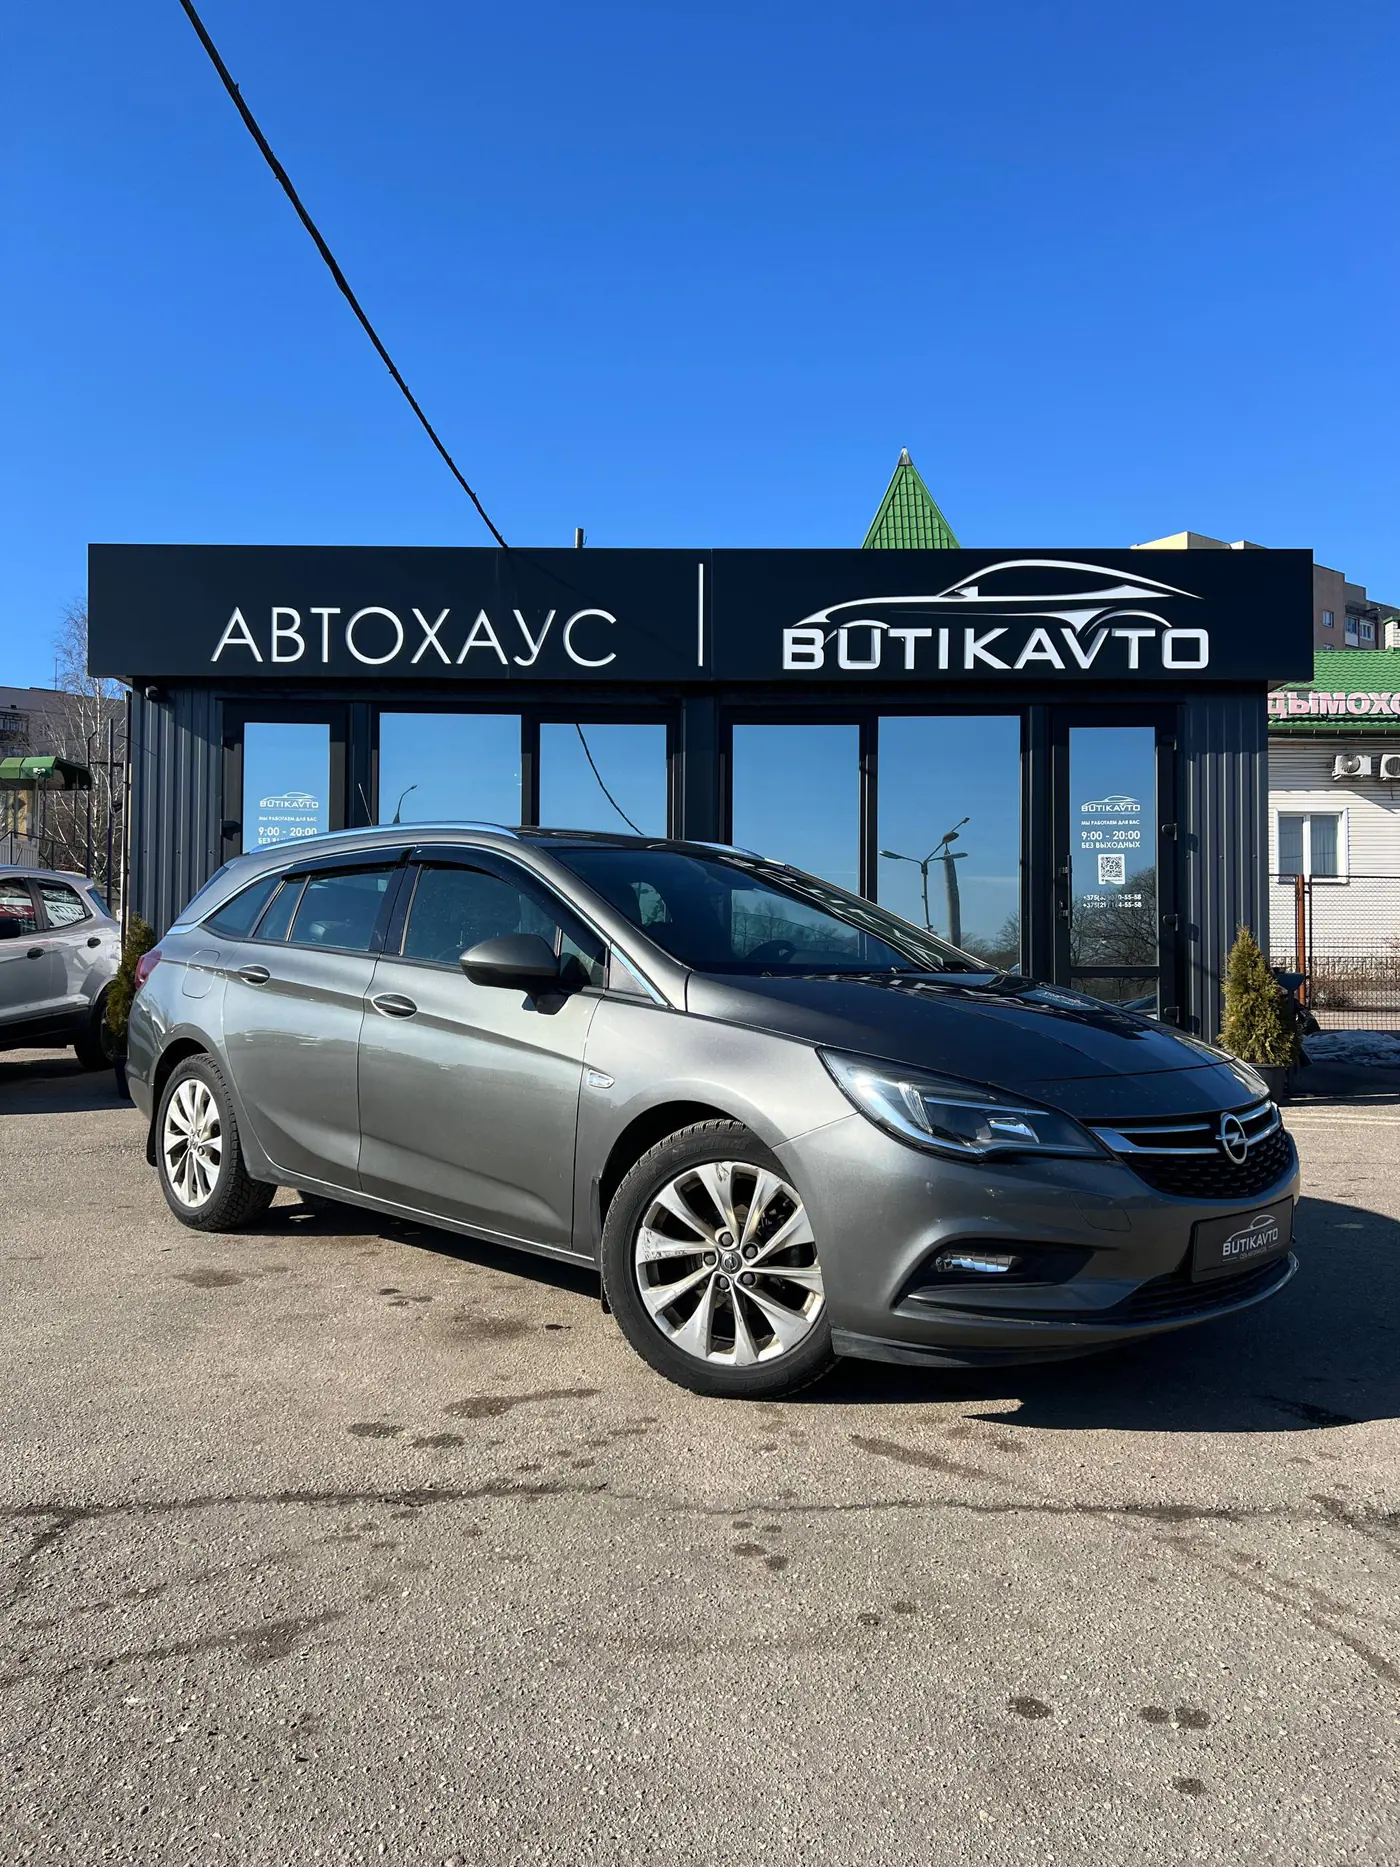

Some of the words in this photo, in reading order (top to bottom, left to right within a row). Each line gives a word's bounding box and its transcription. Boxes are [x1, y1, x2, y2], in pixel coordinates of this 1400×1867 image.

[211, 606, 617, 667] АВТОХАУС
[782, 627, 1210, 670] BUTIKAVTO
[259, 800, 319, 808] BUTIKAVTO
[1081, 804, 1140, 812] BUTIKAVTO
[258, 826, 280, 836] 9:00
[290, 827, 317, 836] 20:00
[1081, 831, 1103, 840] 9:00
[1112, 830, 1140, 840] 20:00
[1081, 841, 1094, 849] БЕЗ
[1095, 841, 1140, 849] ВЫХОДНЫХ
[1222, 1228, 1278, 1256] BUTIKAVTO
